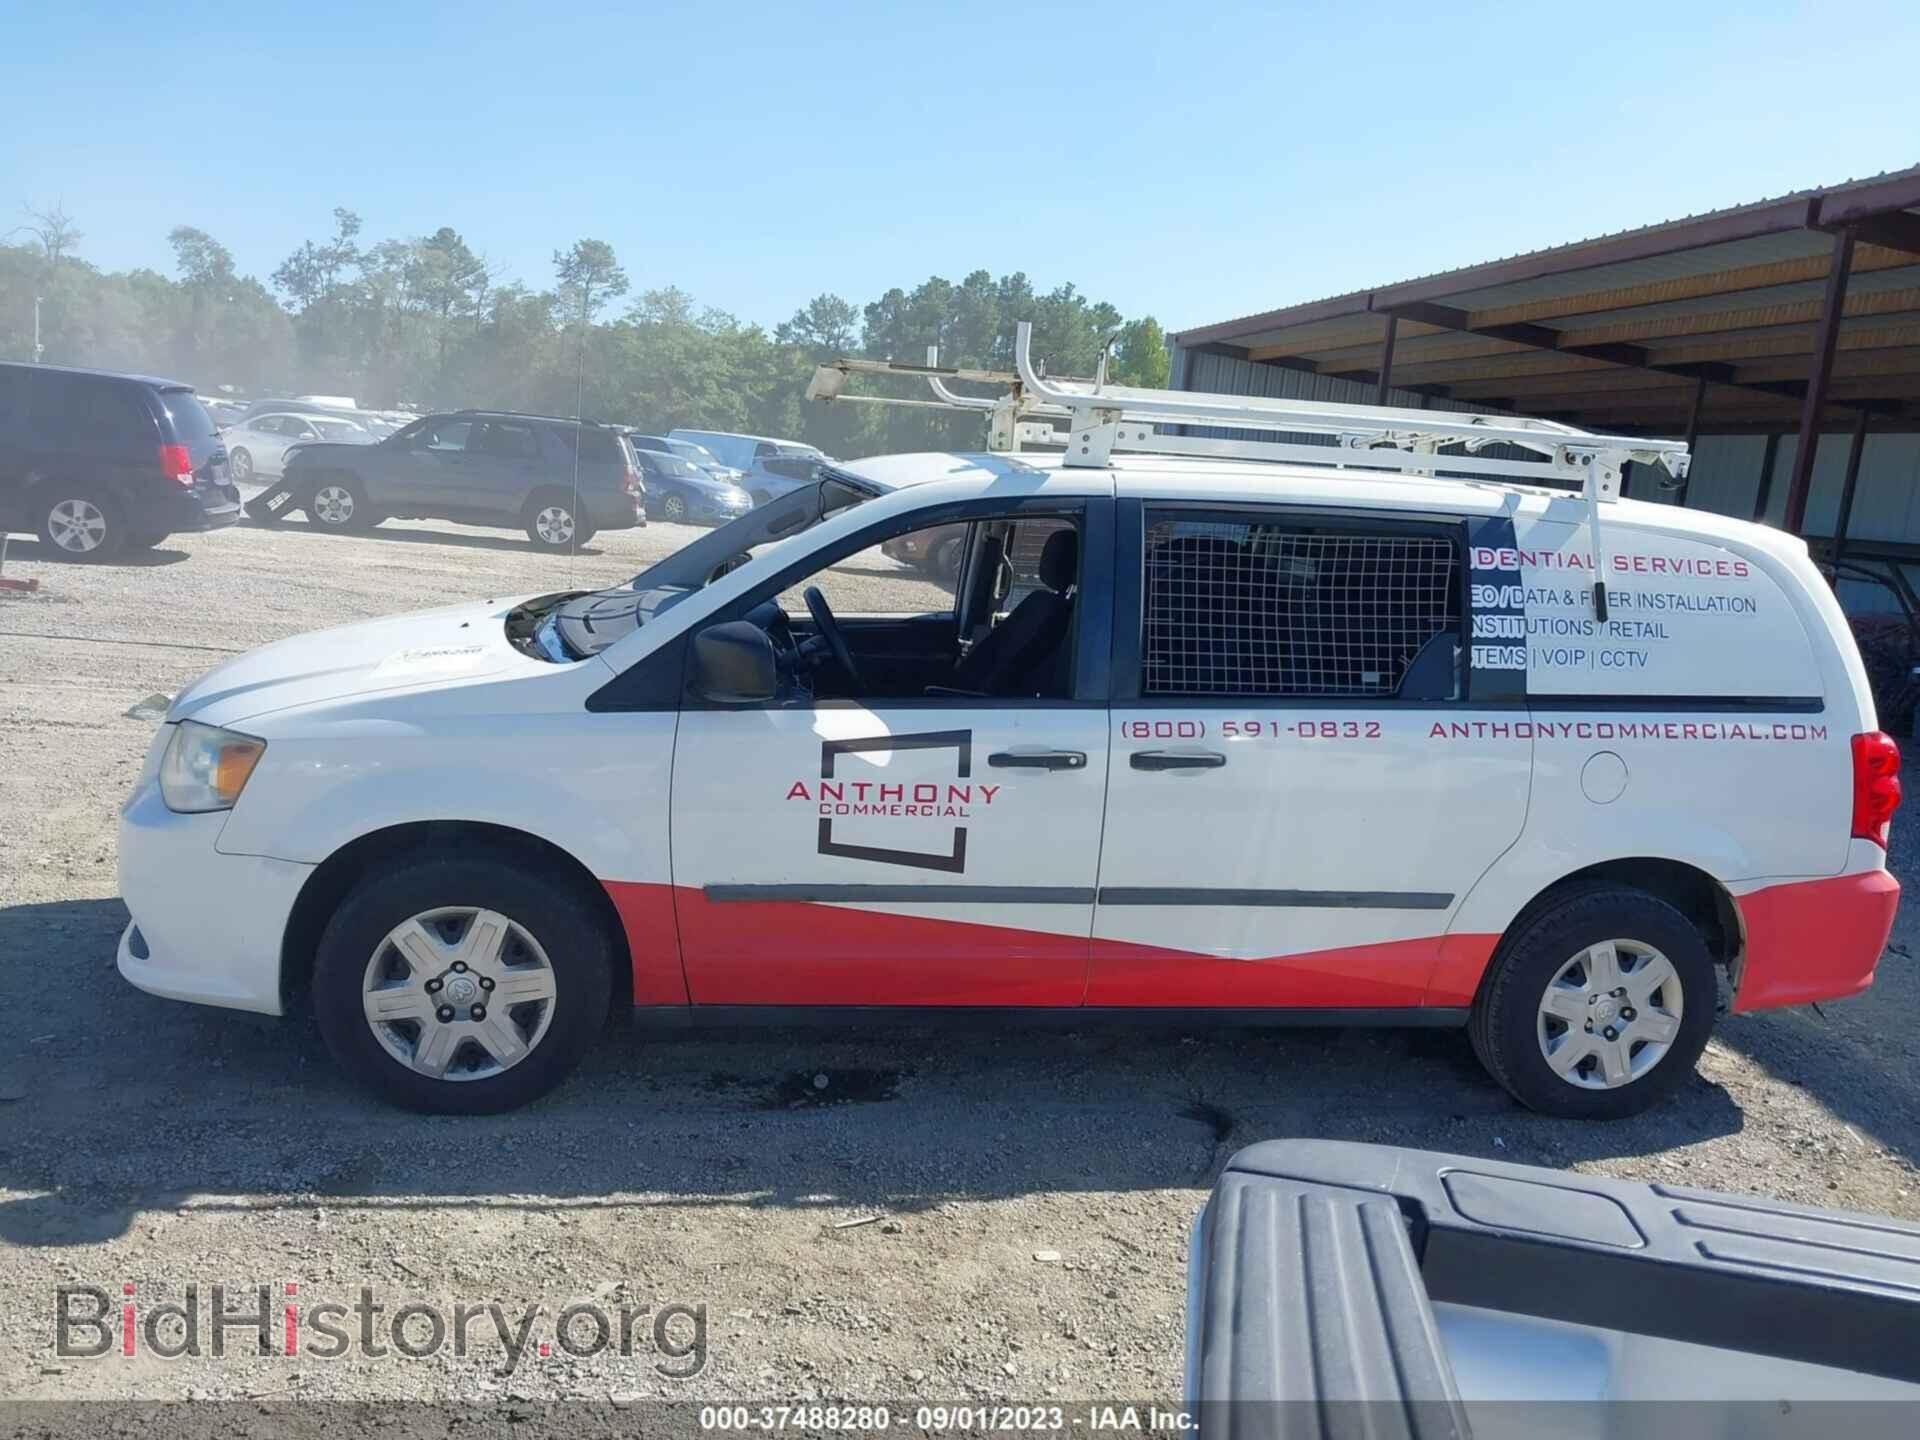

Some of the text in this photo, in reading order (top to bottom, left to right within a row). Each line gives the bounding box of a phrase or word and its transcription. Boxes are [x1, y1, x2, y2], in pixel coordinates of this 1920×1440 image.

[1613, 554, 1750, 578] SERVICES
[1562, 591, 1575, 606] &
[1580, 590, 1632, 607] FIER
[1637, 592, 1757, 613] INSTALLATION
[1608, 620, 1670, 639] RETAIL
[1542, 648, 1586, 667] VOIP
[1600, 650, 1649, 668] CCTV
[1120, 721, 1382, 739] (800) 591-0832
[1429, 721, 1828, 741] ANTHONYCOMMERCIAL.COM
[786, 781, 1001, 804] ANTHONY
[818, 802, 971, 818] COMMERCIAL
